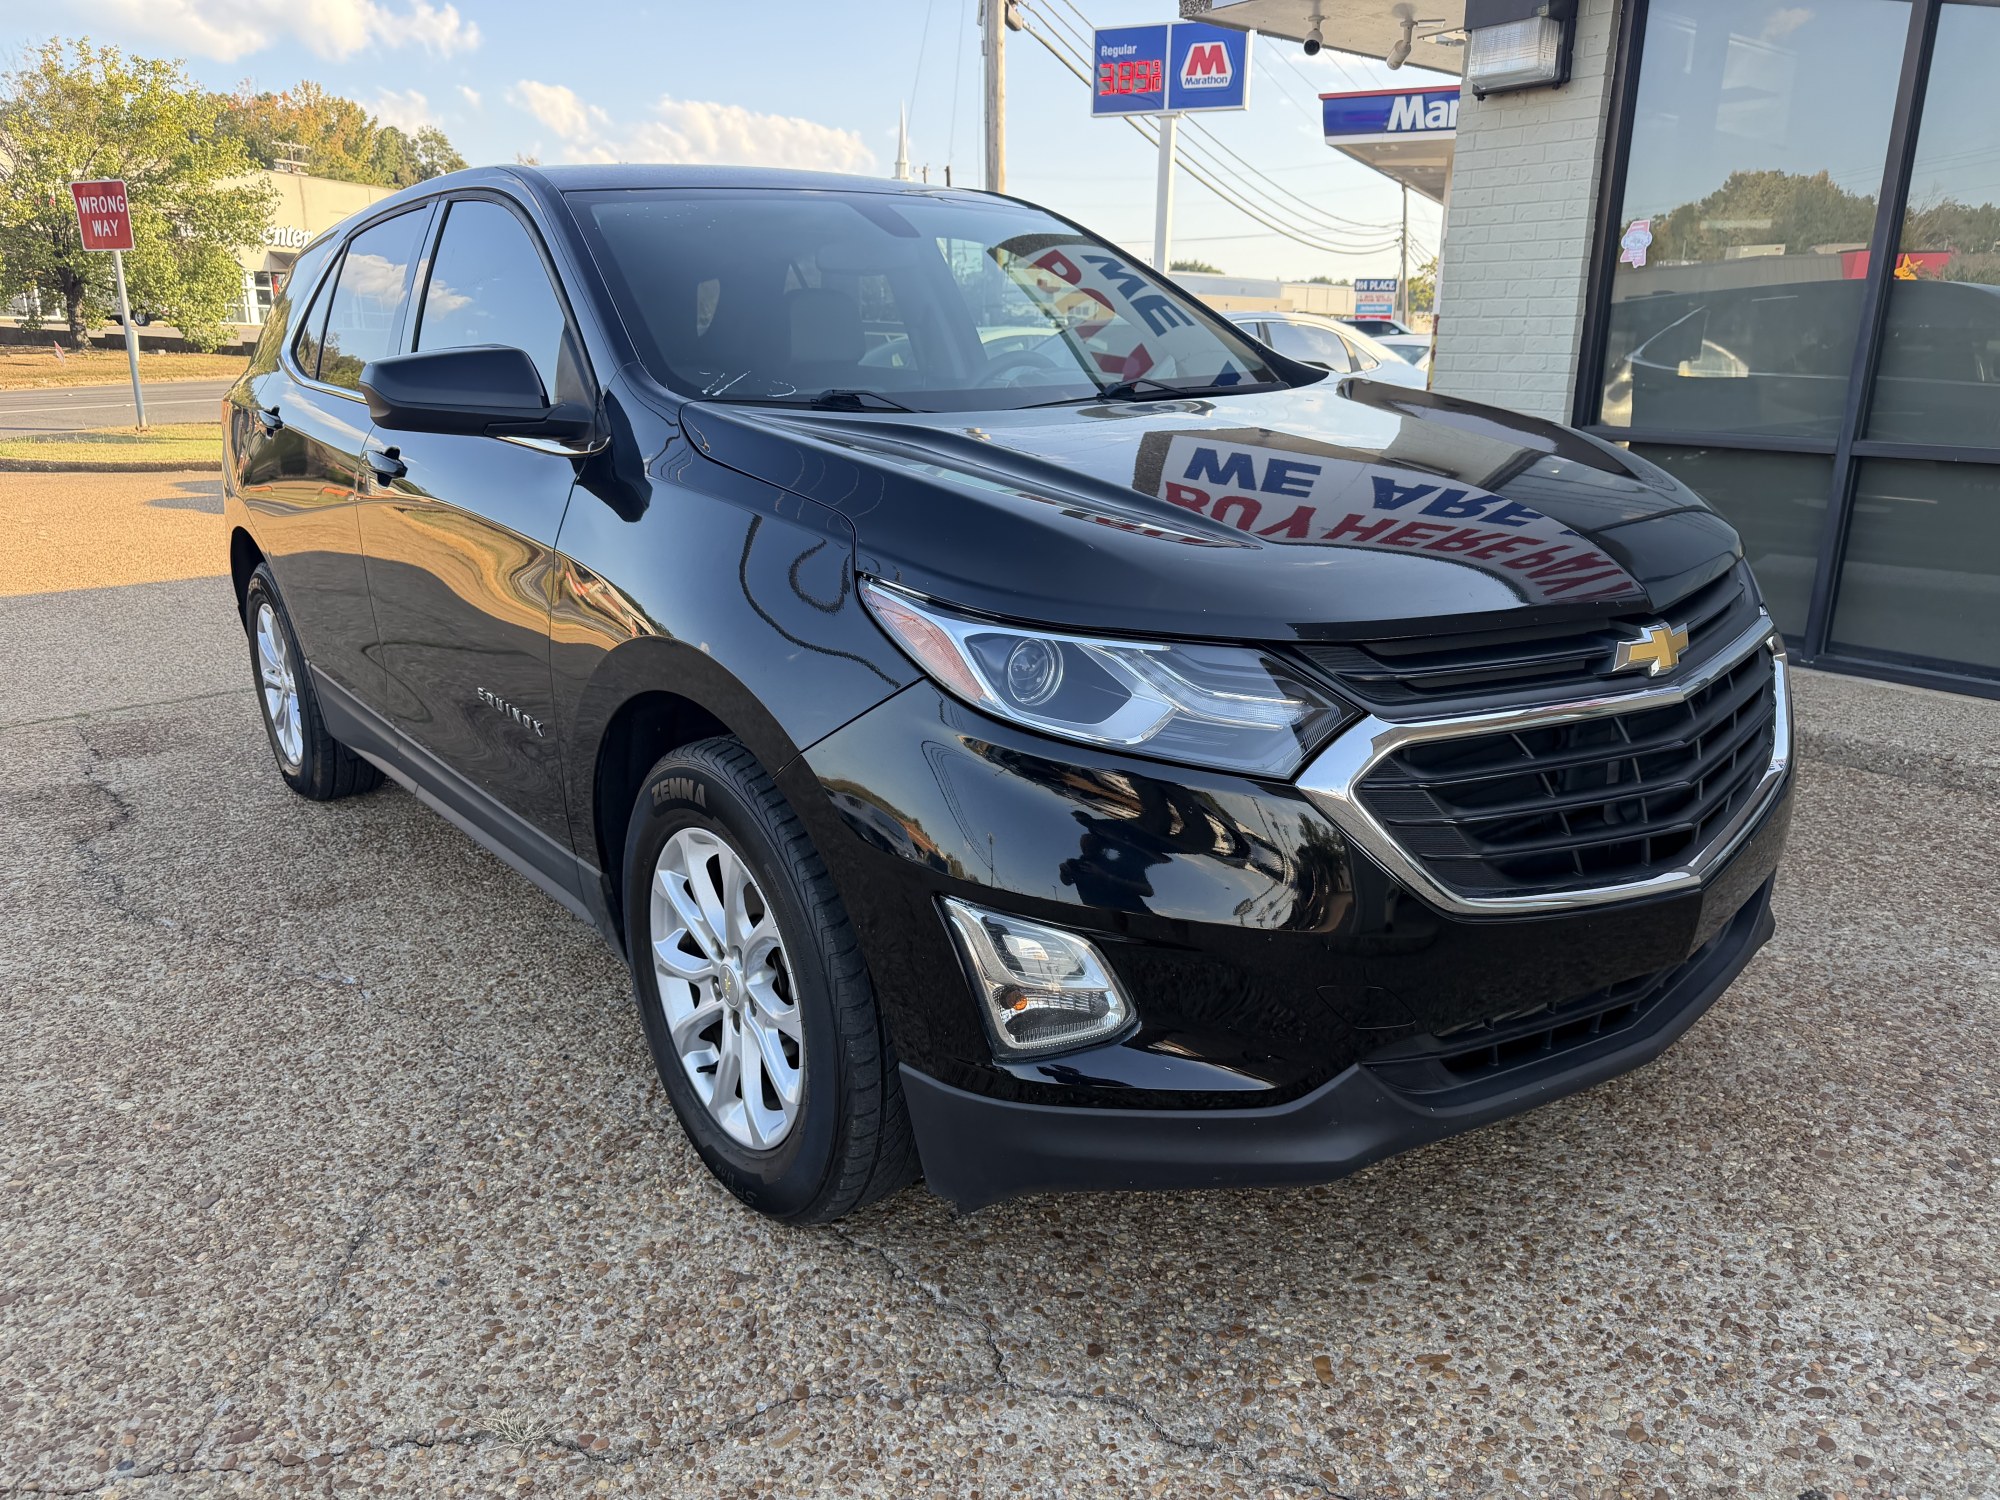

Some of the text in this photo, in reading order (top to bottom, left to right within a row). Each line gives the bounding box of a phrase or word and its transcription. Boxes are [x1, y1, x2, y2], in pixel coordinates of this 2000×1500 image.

[1101, 44, 1137, 57] Regular
[1099, 60, 1150, 96] 3.89
[1184, 75, 1228, 86] Marathon
[79, 194, 125, 214] WRONG
[92, 219, 119, 237] WAY
[262, 225, 314, 249] enter
[1370, 280, 1395, 291] PLACE
[477, 686, 546, 738] EQUINOX
[651, 777, 707, 809] ZENNA
